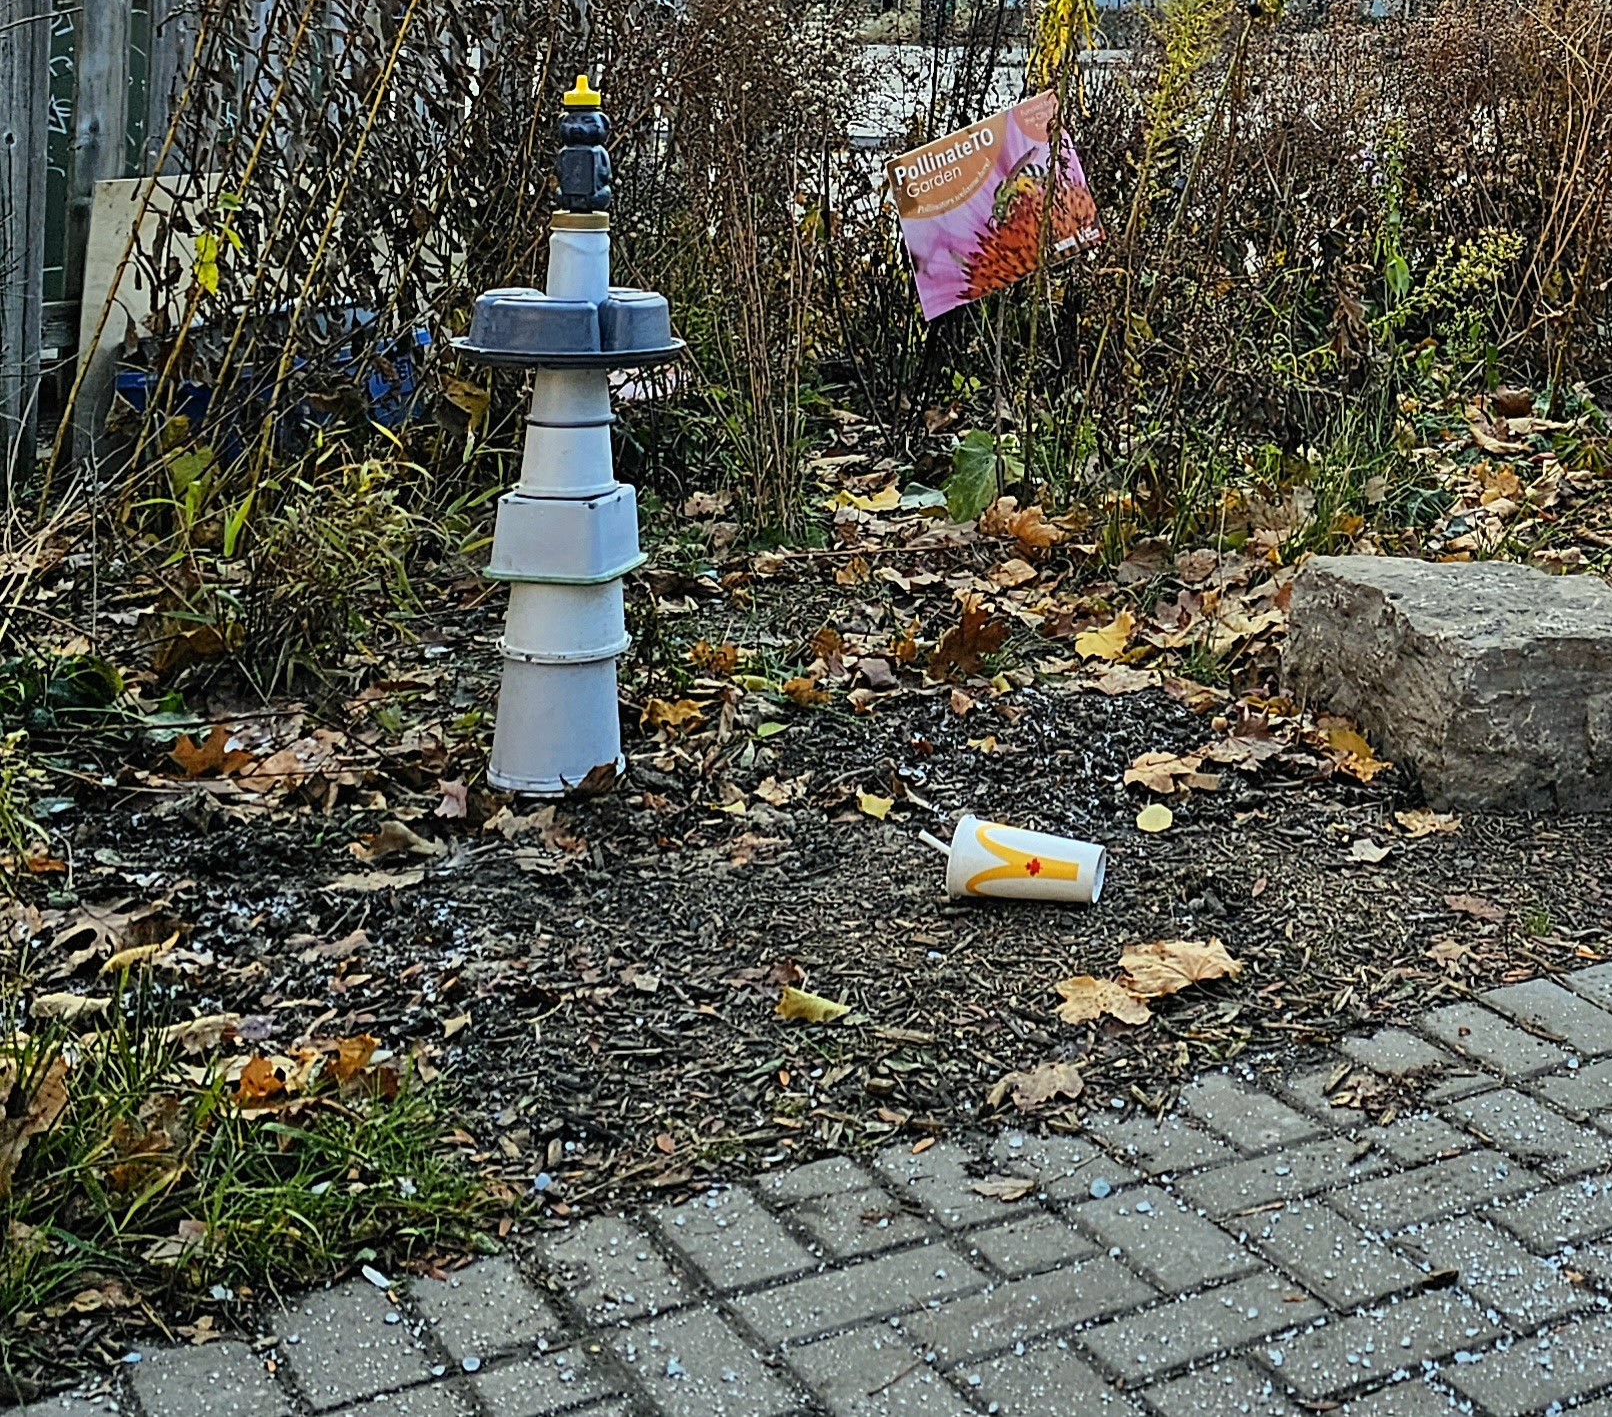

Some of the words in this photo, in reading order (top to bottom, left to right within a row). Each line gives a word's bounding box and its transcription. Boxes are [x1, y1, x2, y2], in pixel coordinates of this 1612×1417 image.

[894, 127, 994, 186] PollinateTO
[906, 166, 962, 198] Garden
[917, 197, 955, 214] Pollinators
